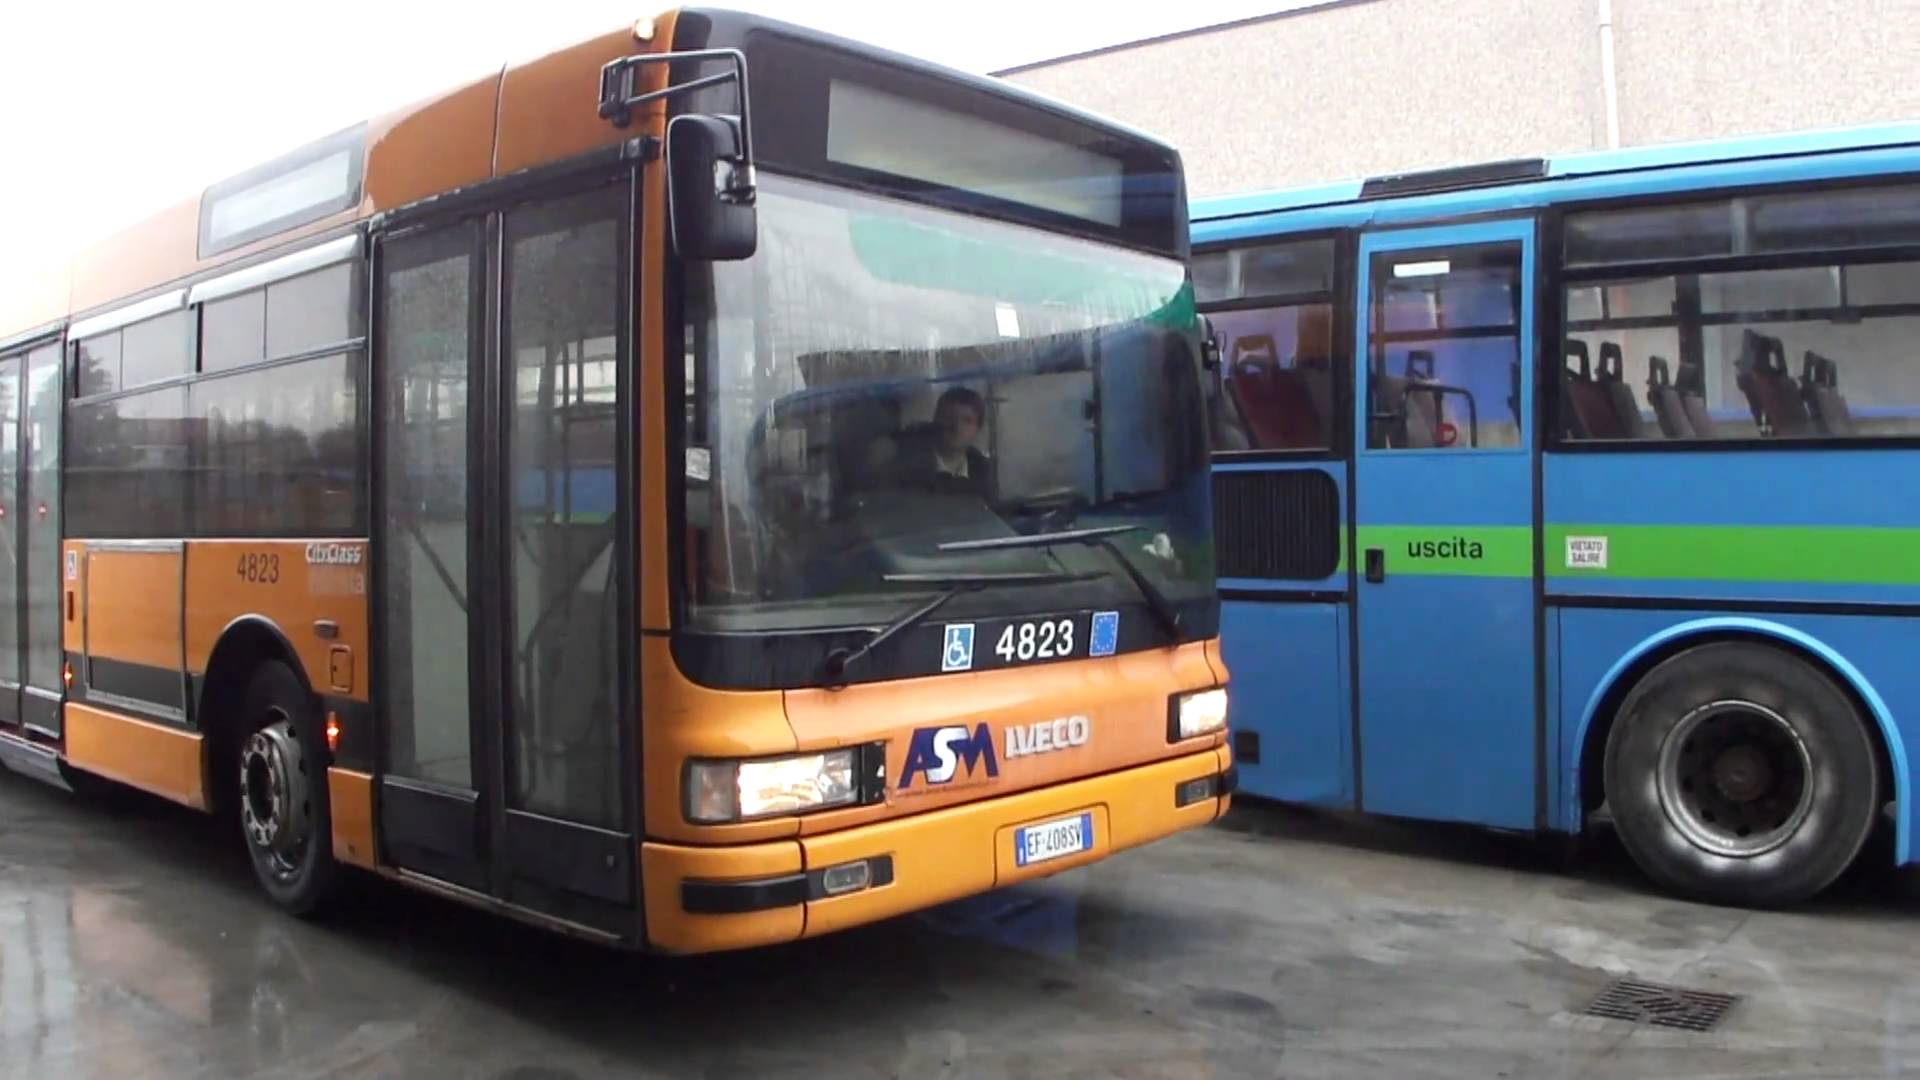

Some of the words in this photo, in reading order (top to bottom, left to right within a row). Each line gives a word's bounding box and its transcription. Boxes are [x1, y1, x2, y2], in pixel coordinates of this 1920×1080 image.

[305, 542, 362, 564] CityClass
[1408, 536, 1483, 559] uscita
[1570, 541, 1603, 551] VIETATO
[1572, 552, 1601, 563] SALIRE
[237, 553, 280, 584] 4823
[995, 619, 1074, 662] 4823
[1004, 715, 1089, 760] IVECO
[897, 722, 999, 789] ASM
